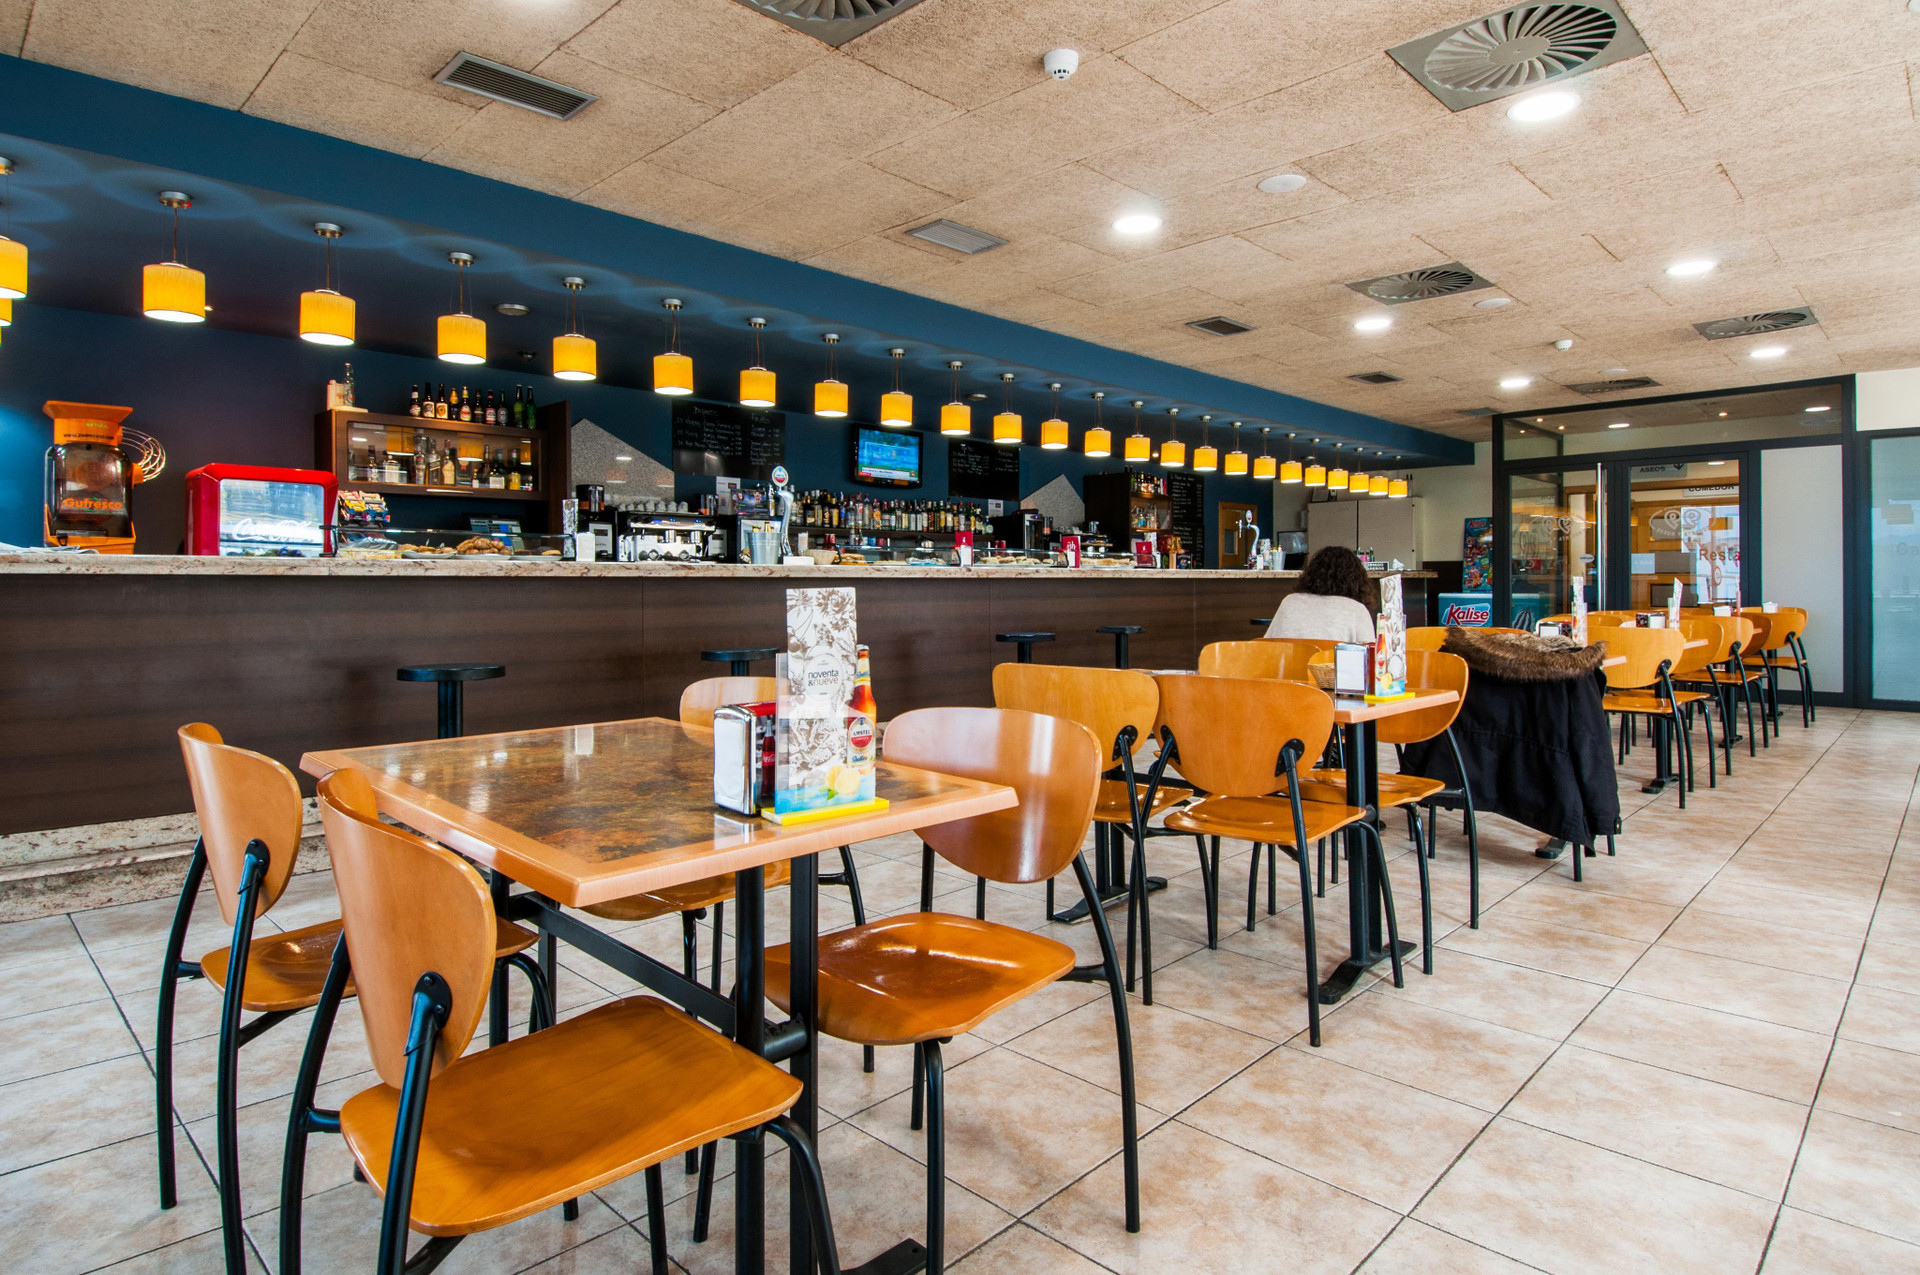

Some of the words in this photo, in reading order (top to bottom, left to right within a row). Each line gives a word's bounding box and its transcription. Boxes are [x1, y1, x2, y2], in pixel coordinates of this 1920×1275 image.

[1640, 465, 1666, 473] ASEOS
[65, 498, 122, 510] Gufresco
[1446, 604, 1489, 625] Kalise
[808, 669, 839, 678] noventa
[808, 677, 839, 687] &nueve
